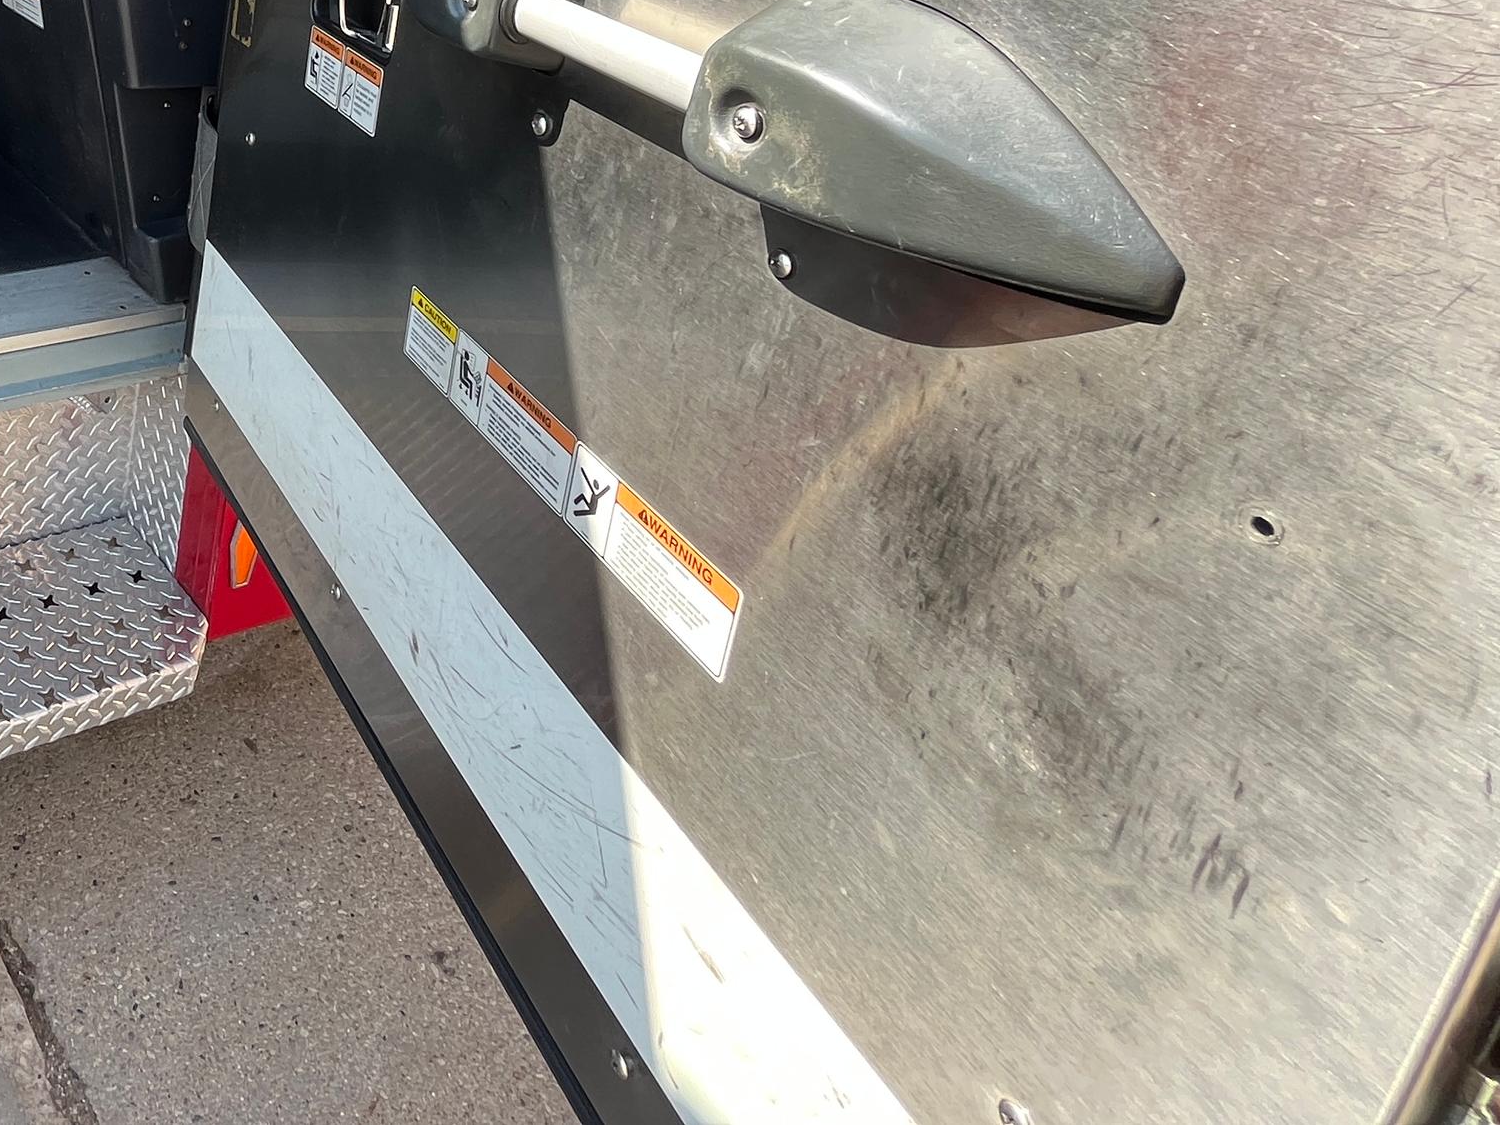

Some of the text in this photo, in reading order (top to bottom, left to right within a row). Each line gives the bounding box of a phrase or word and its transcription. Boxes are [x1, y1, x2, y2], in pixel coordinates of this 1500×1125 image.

[424, 304, 452, 335] CAUTION
[514, 387, 553, 429] WARNING
[647, 515, 715, 585] WARNING
